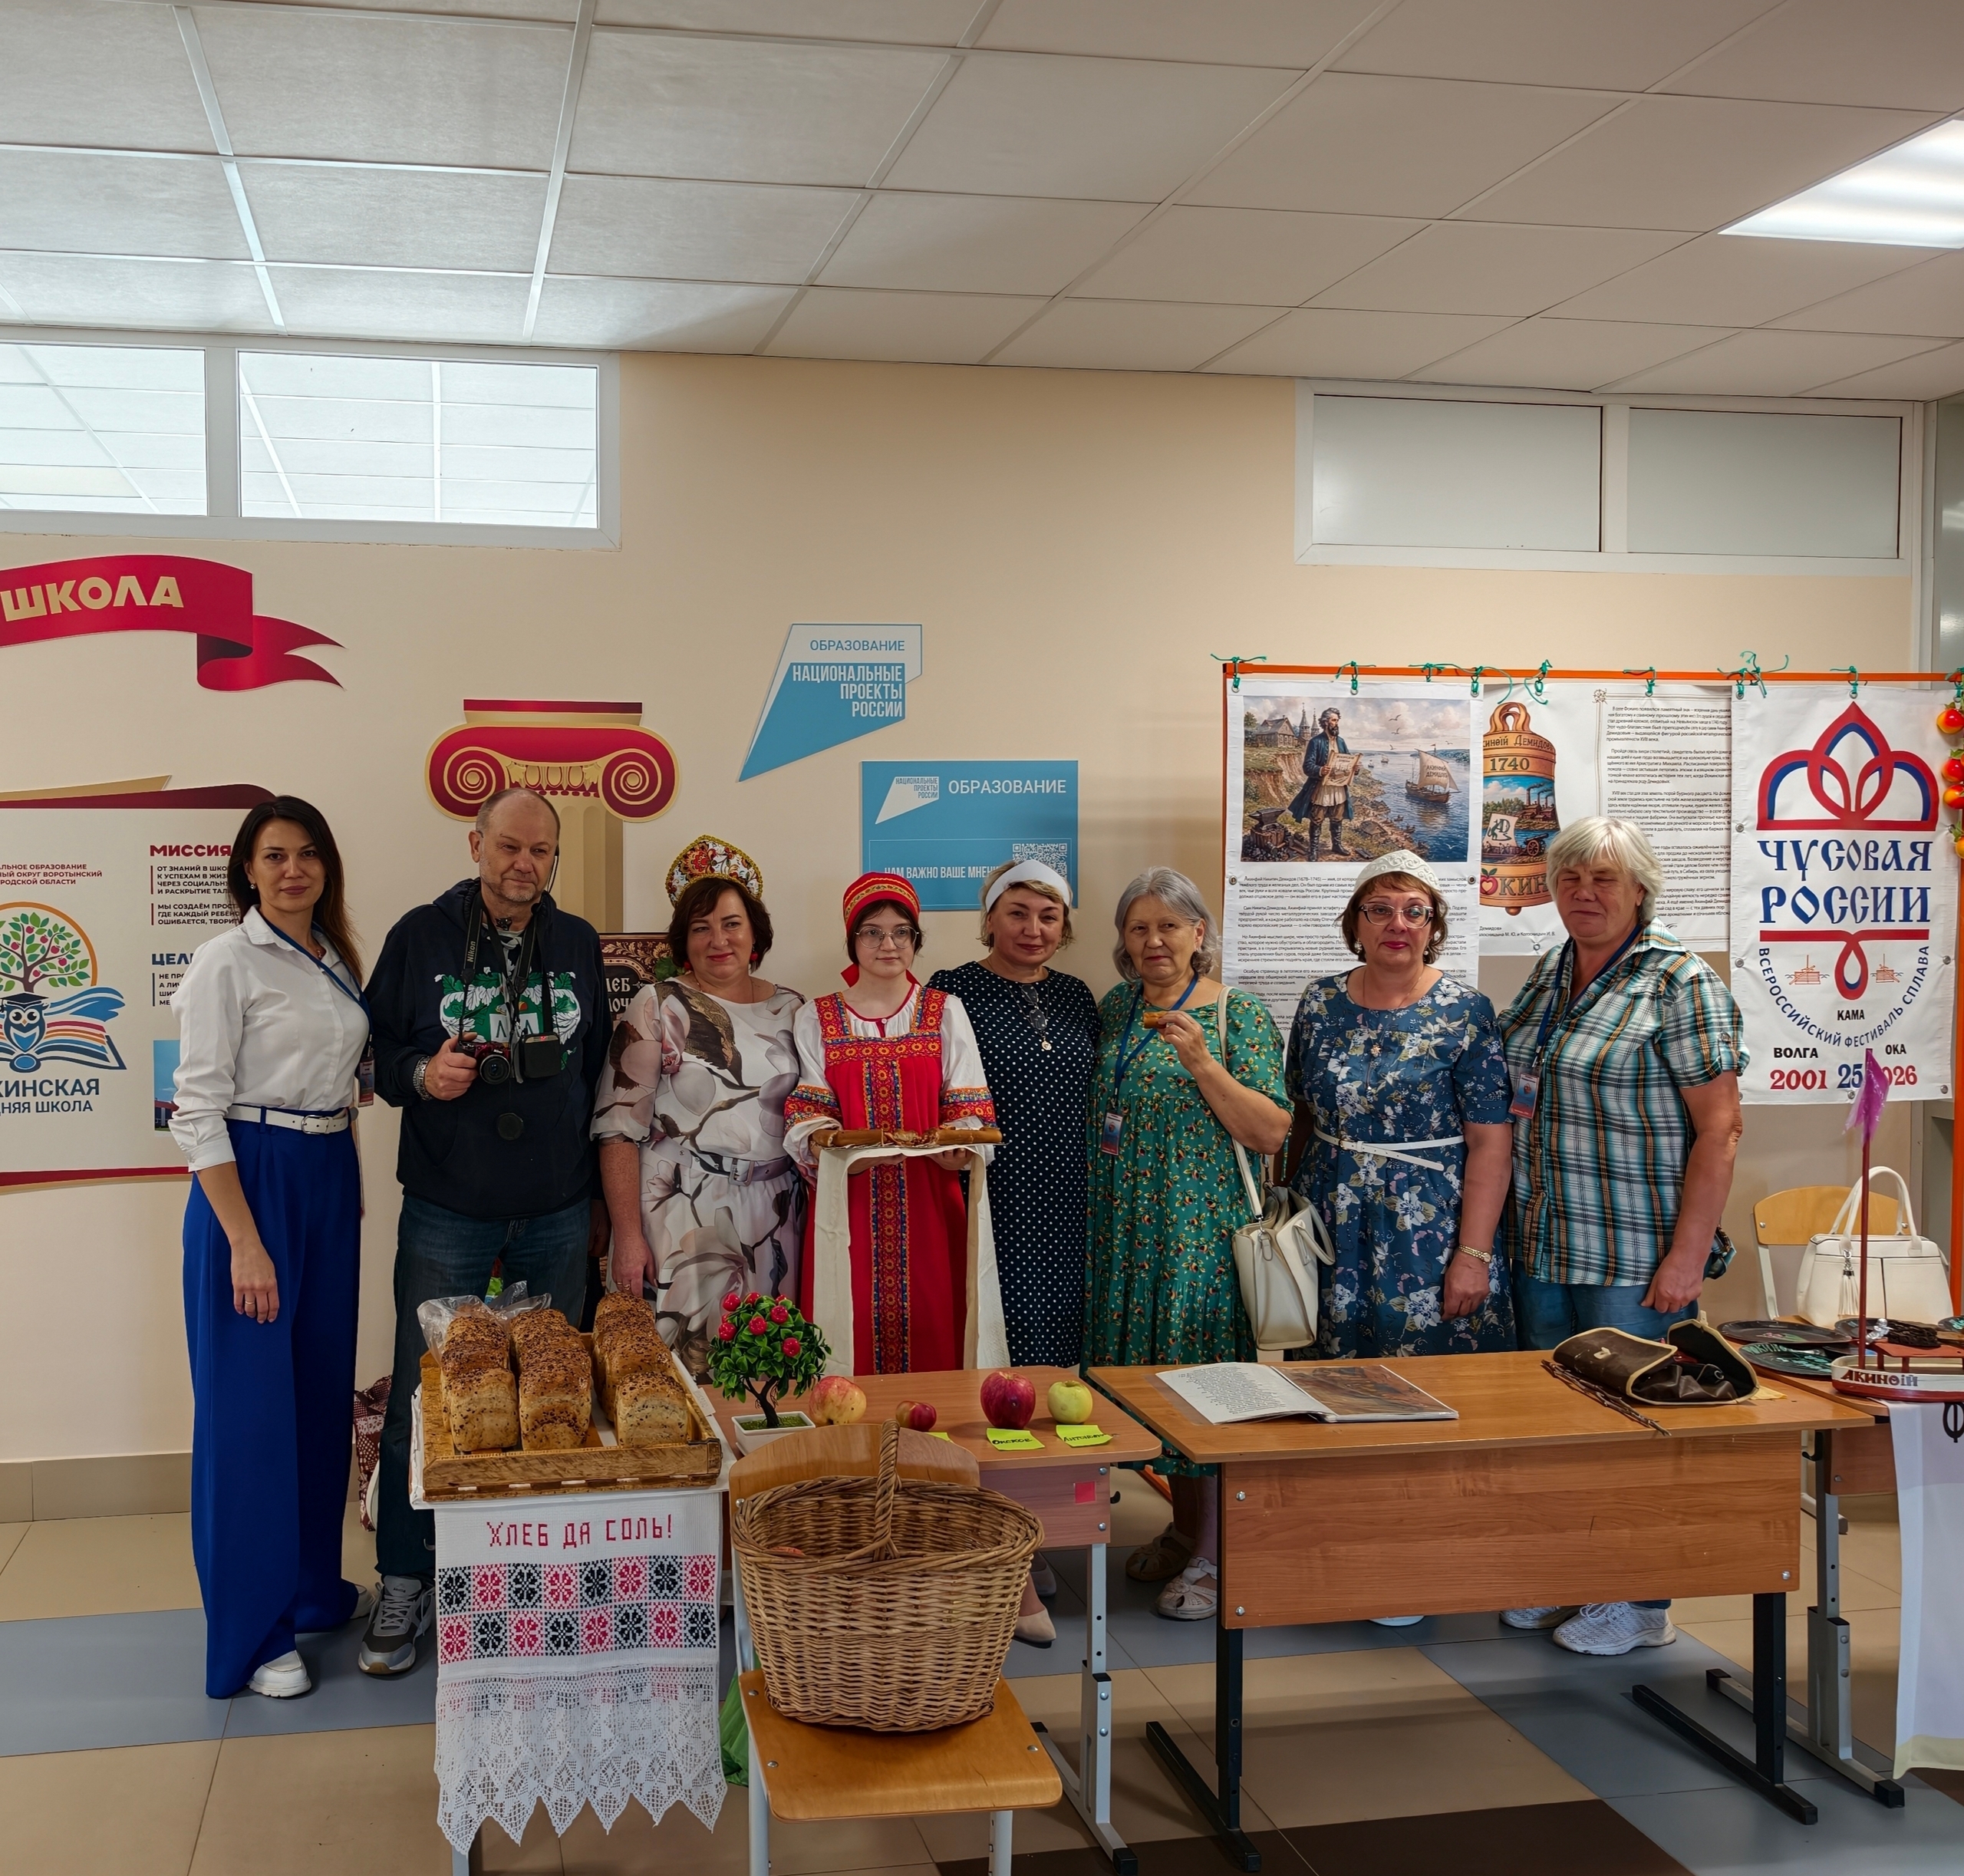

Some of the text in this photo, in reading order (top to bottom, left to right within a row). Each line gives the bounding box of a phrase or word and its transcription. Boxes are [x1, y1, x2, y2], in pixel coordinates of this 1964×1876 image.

[0, 575, 184, 622] ШКОЛА
[809, 639, 905, 651] ОБРАЗОВАНИЕ
[793, 664, 903, 683] НАЦИОНАЛЬНЫЕ
[840, 684, 903, 699] ПРОЕКТЫ
[852, 701, 903, 717] РОССИИ
[1490, 757, 1531, 771] 1740
[895, 777, 938, 786] НАЦИОНАЛЬНЫЕ
[948, 780, 1066, 794] ОБРАЗОВАНИЕ
[150, 844, 232, 857] МИССИЯ
[1757, 839, 1934, 882] ЧУСОВАЯ
[906, 867, 938, 879] ВАЖНО
[941, 866, 966, 879] ВАШЕ
[1759, 885, 1931, 925] РОССИИ
[466, 941, 476, 962] Nikon
[1758, 945, 1930, 1048] ВСЕРОССИЙСКИЙ ФЕСТИВАЛЬ СПЛАВА
[1837, 1009, 1866, 1021] КАМА
[1773, 1047, 1819, 1060] ВОЛГА
[1885, 1044, 1907, 1056] ОКА
[1770, 1069, 1828, 1090] 2001
[1837, 1063, 1863, 1089] 25
[1882, 1065, 1917, 1086] 026
[0, 1100, 94, 1116] НЯЯ ШКОЛА
[486, 1514, 672, 1549] ХЛЕБ ДА СОЛЬ!
